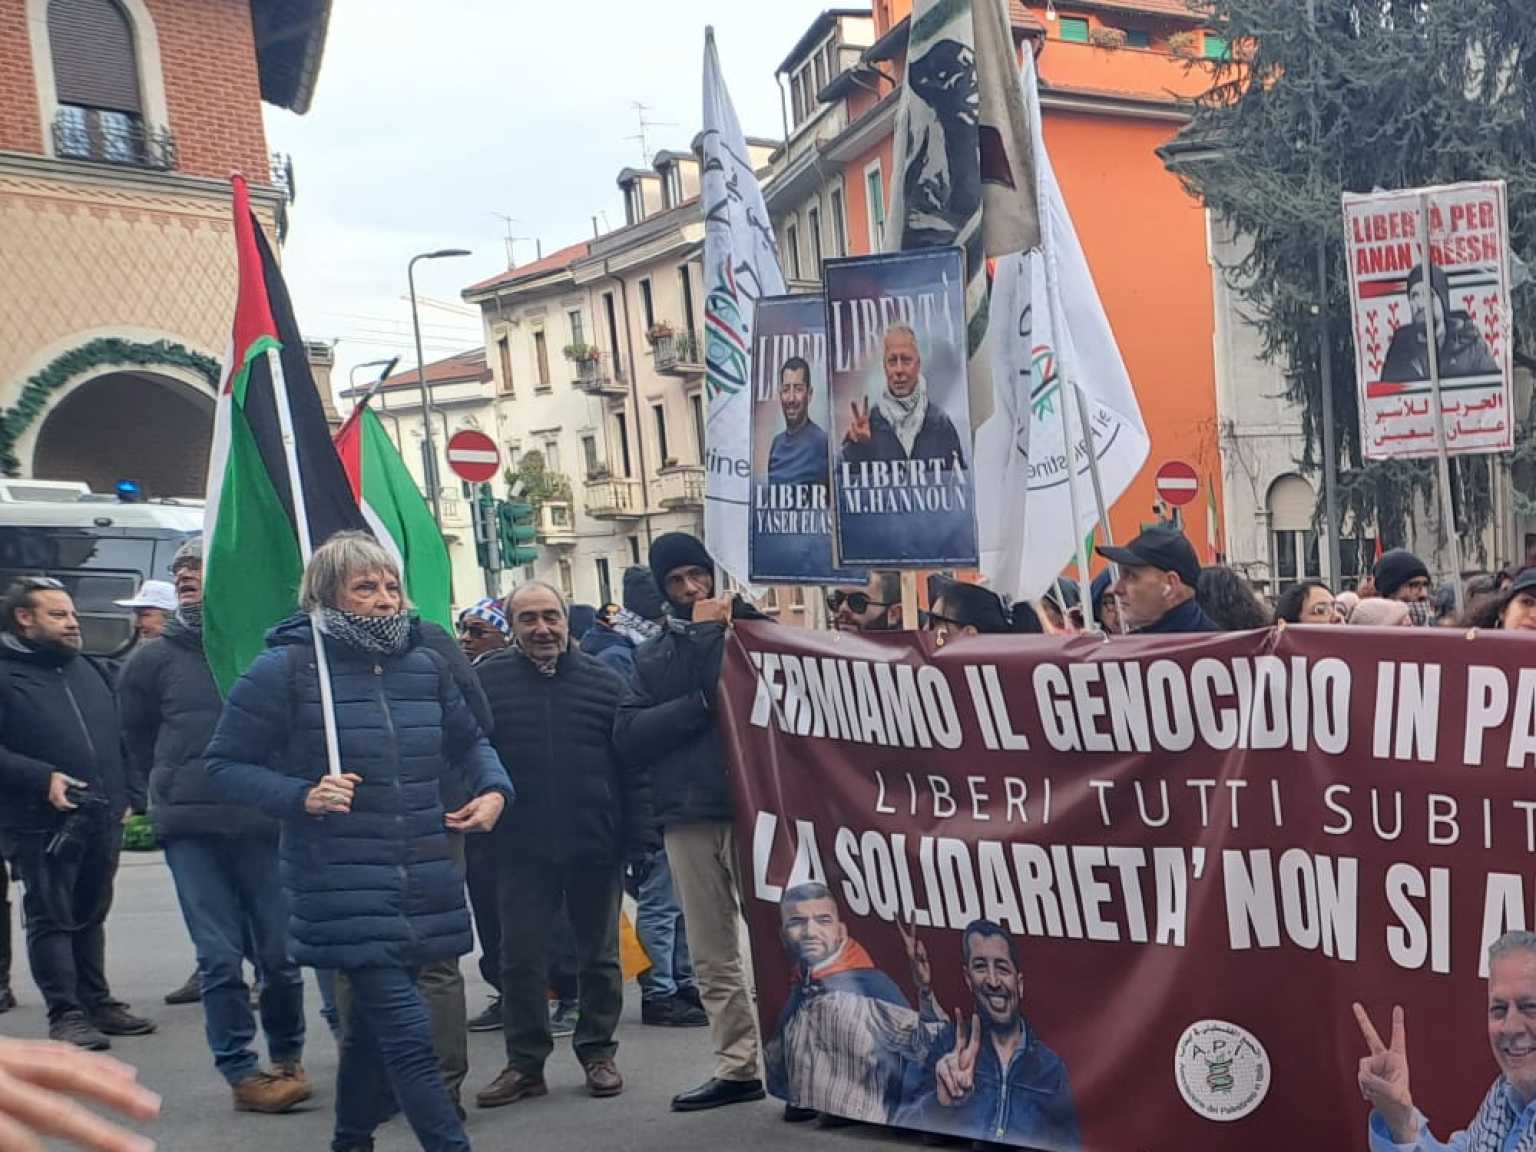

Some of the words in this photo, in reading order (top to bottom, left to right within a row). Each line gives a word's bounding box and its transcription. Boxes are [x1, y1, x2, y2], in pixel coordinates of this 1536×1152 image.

[1353, 202, 1444, 243] LIBERÀ
[1450, 201, 1495, 232] PER
[1357, 242, 1413, 274] ANAN
[1416, 233, 1497, 266] AEESH
[1441, 392, 1503, 418] الحري
[841, 450, 968, 488] LIBERTÀ
[844, 485, 967, 514] M.HANNOUN
[750, 651, 963, 749] FERMIAMO
[965, 664, 1030, 751] IL
[1032, 656, 1351, 754] GENOCIDIO
[1373, 661, 1441, 762] IN
[875, 769, 1051, 825] LIBERI
[1090, 778, 1282, 829] TUTTI
[753, 810, 828, 903] LA
[1222, 848, 1358, 961] NON
[1385, 862, 1450, 974] SI
